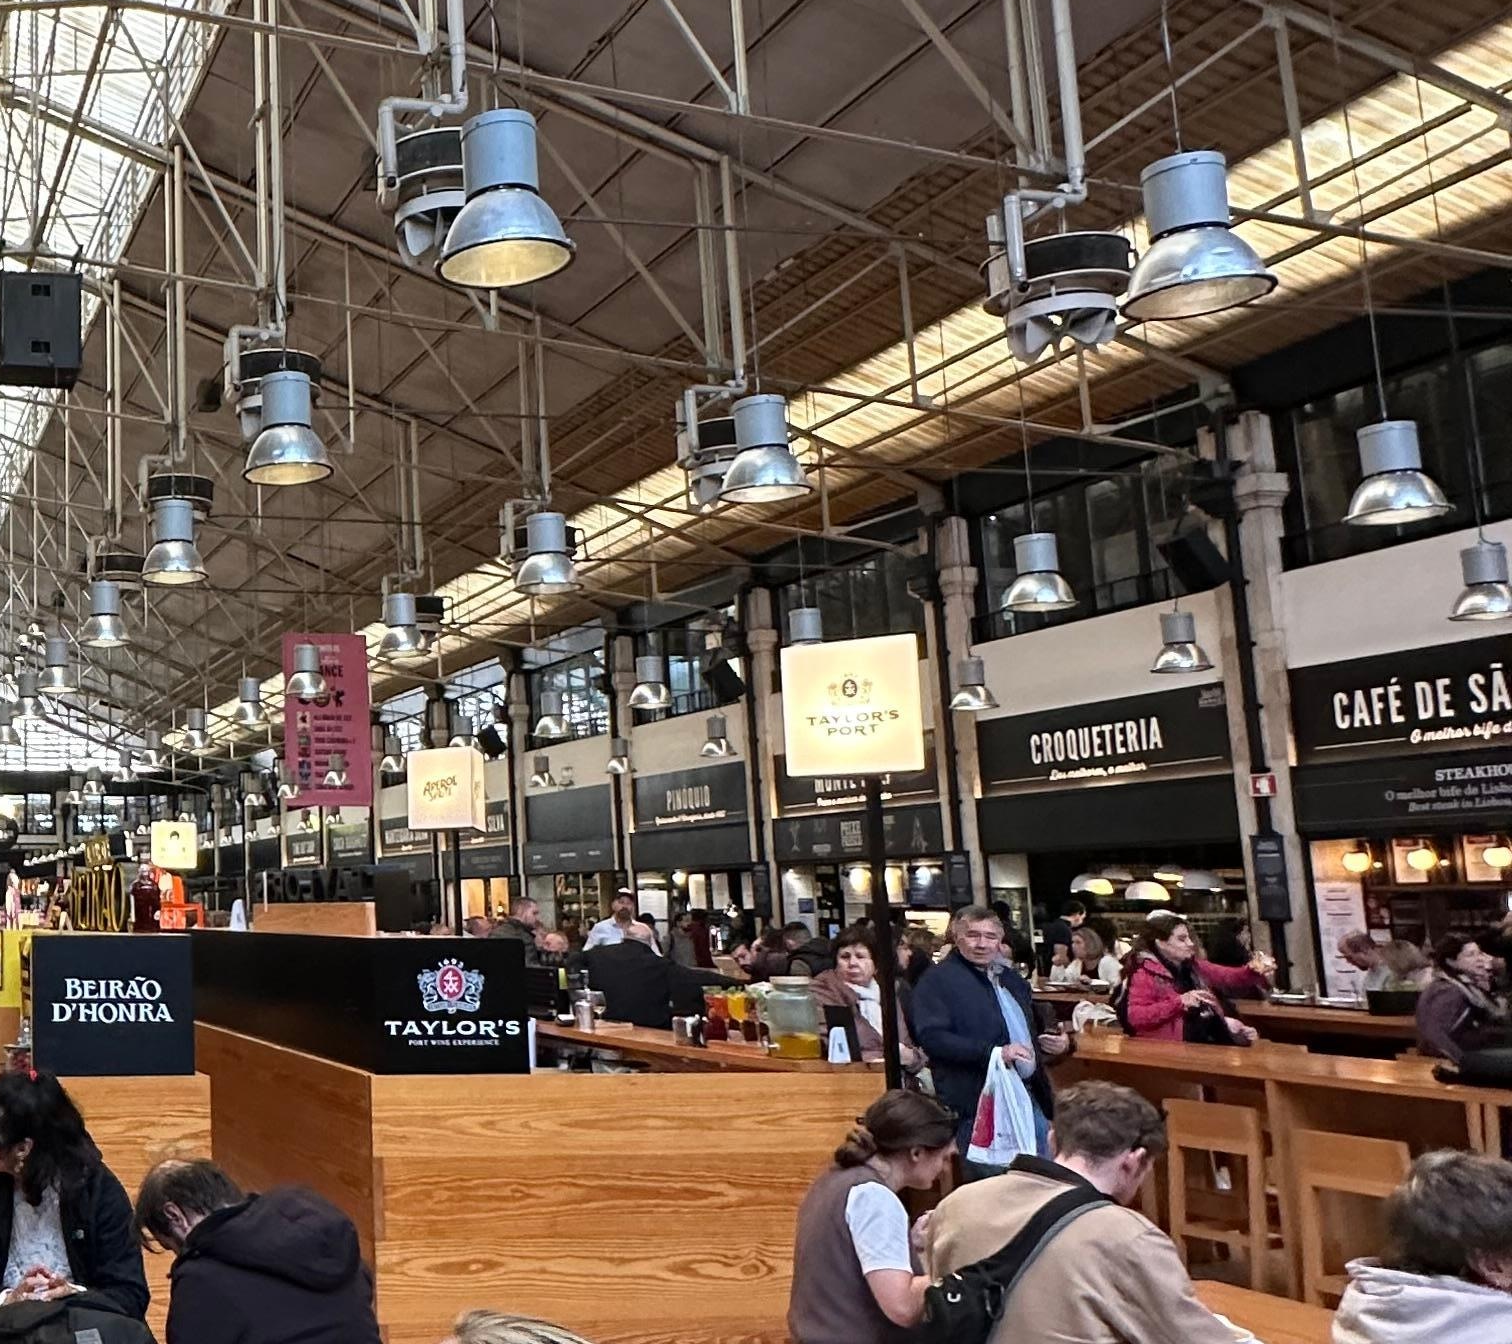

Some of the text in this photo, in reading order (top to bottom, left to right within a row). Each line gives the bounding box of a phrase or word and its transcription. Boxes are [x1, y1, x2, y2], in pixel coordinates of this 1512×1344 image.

[1333, 677, 1406, 729] CAFÉ
[1414, 677, 1456, 721] DE
[806, 709, 900, 726] TAYLOR'S
[827, 724, 879, 736] PORT
[1029, 716, 1164, 765] CROQUETERIA
[1423, 726, 1472, 741] melhor
[1472, 721, 1501, 739] bife
[64, 976, 162, 1001] BEIRÃO
[51, 1002, 175, 1024] D'HONRA
[384, 1019, 521, 1038] TAYLOR'S
